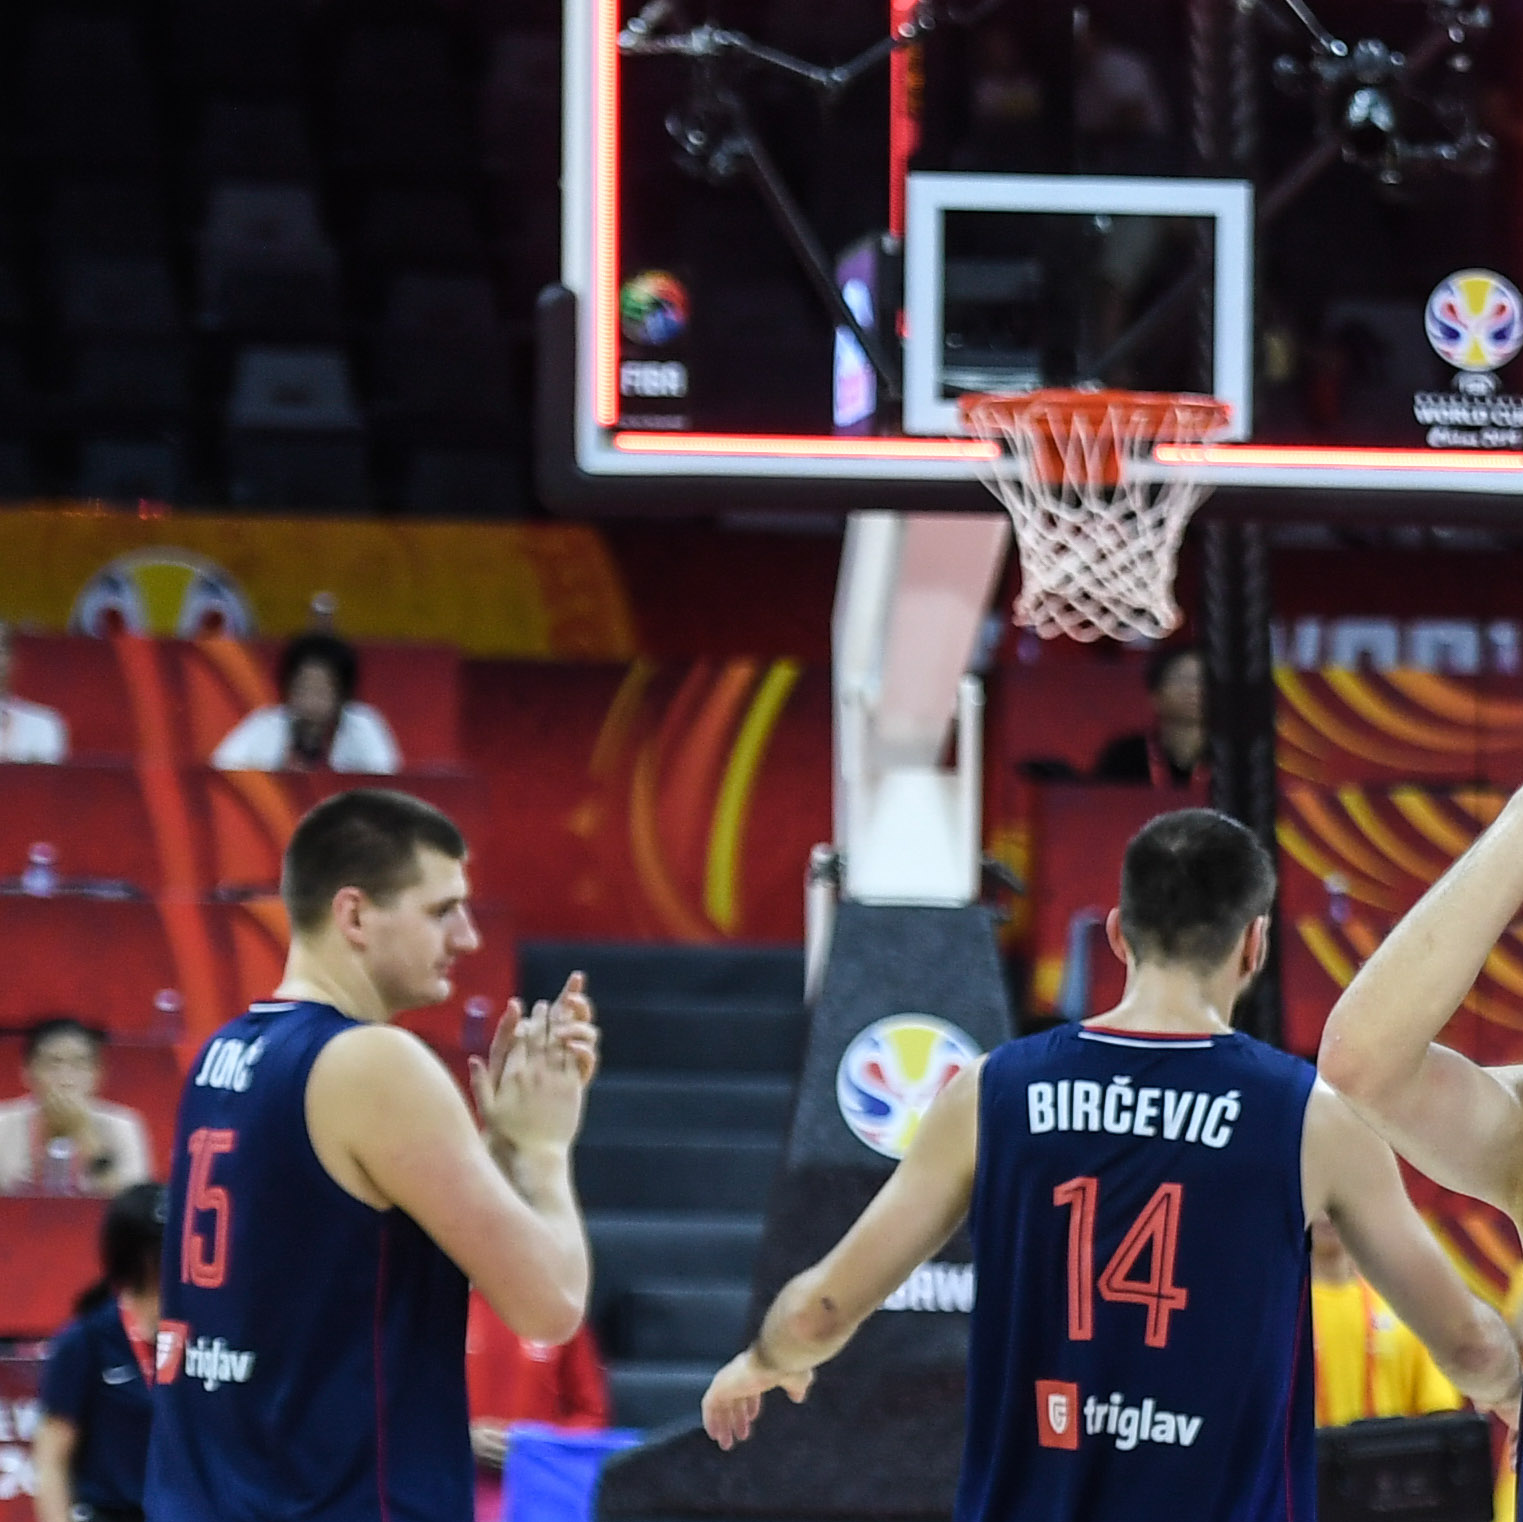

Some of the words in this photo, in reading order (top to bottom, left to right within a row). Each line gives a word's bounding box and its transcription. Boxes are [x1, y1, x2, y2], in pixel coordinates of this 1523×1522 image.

[1027, 1076, 1242, 1149] BIRČEVIĆ
[1053, 1176, 1188, 1349] 14
[1083, 1391, 1204, 1451] triglav
